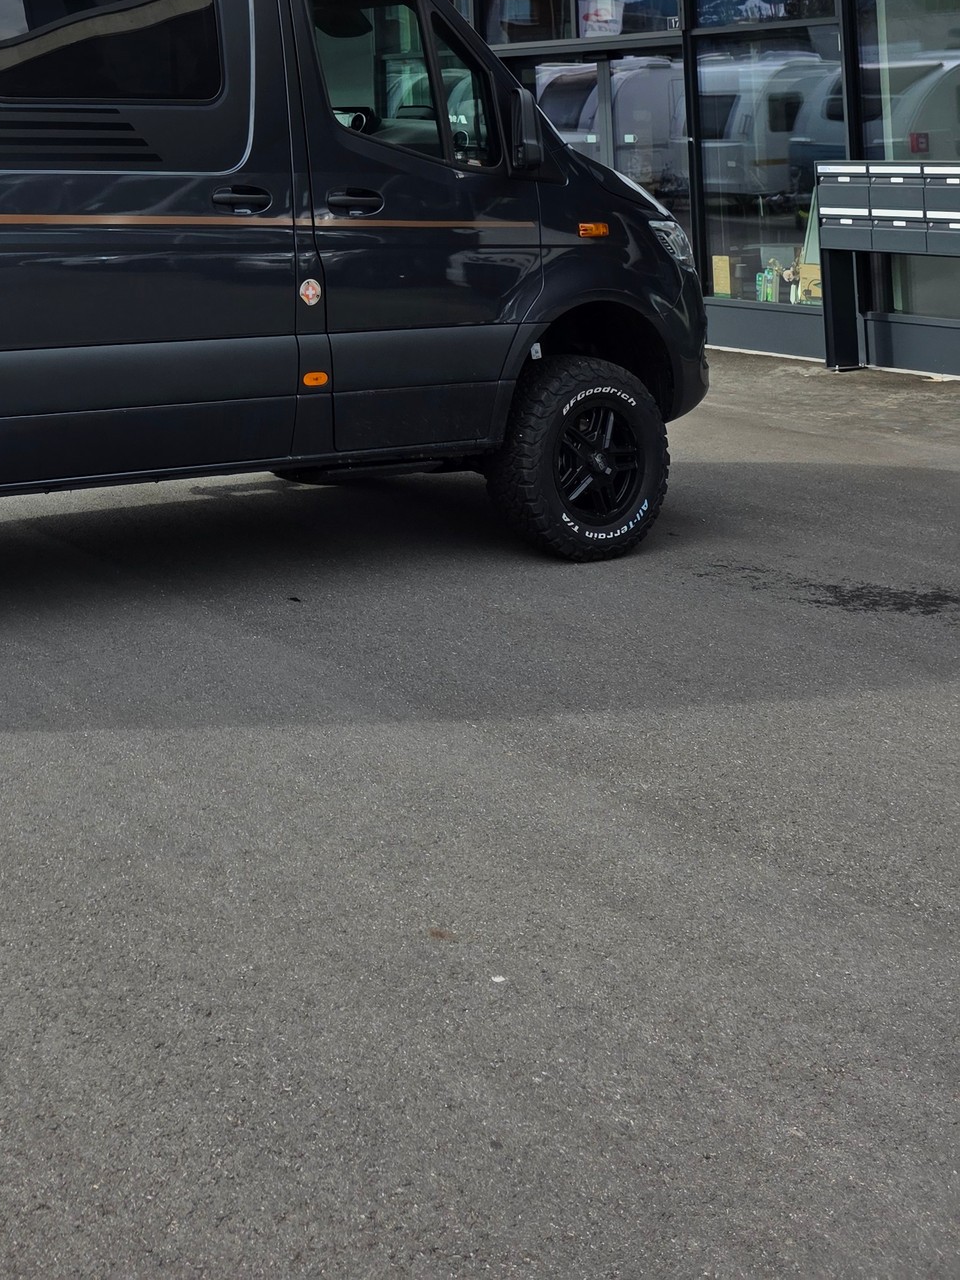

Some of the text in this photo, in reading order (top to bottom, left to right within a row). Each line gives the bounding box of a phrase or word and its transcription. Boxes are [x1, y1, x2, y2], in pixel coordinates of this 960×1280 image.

[562, 386, 637, 416] BFGoodrich
[561, 498, 649, 541] All-Terrain T/A
